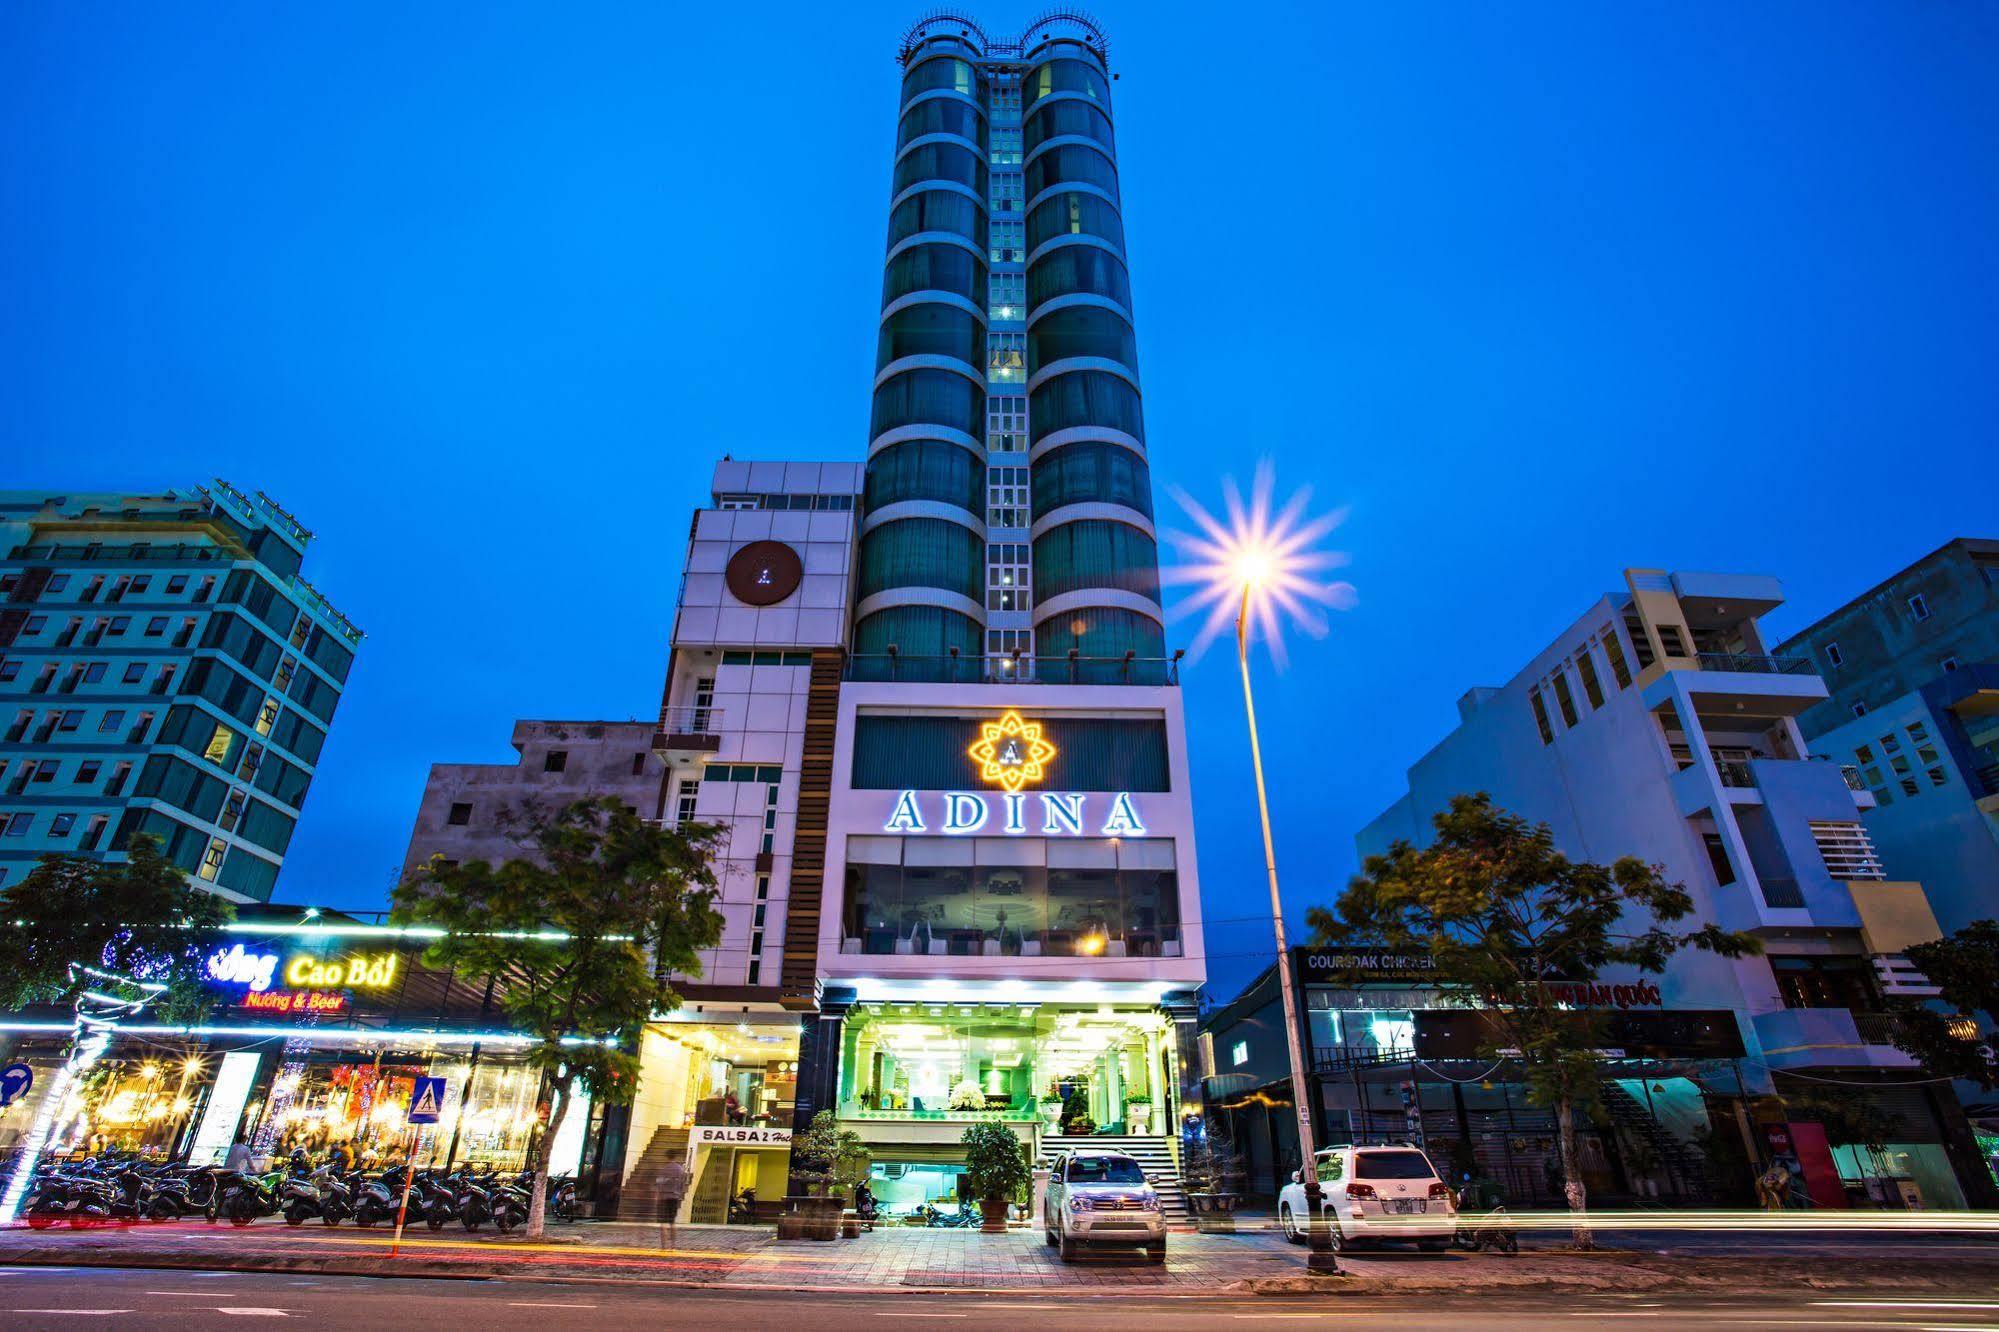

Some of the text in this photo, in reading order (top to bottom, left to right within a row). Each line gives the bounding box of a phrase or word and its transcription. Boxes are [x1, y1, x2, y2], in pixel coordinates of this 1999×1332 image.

[1000, 740, 1023, 764] A
[885, 790, 1147, 836] ADINA
[288, 955, 343, 986] Cao
[293, 993, 306, 1009] &
[308, 993, 344, 1010] Beer
[703, 1130, 759, 1141] SALSA
[762, 1132, 769, 1142] 2
